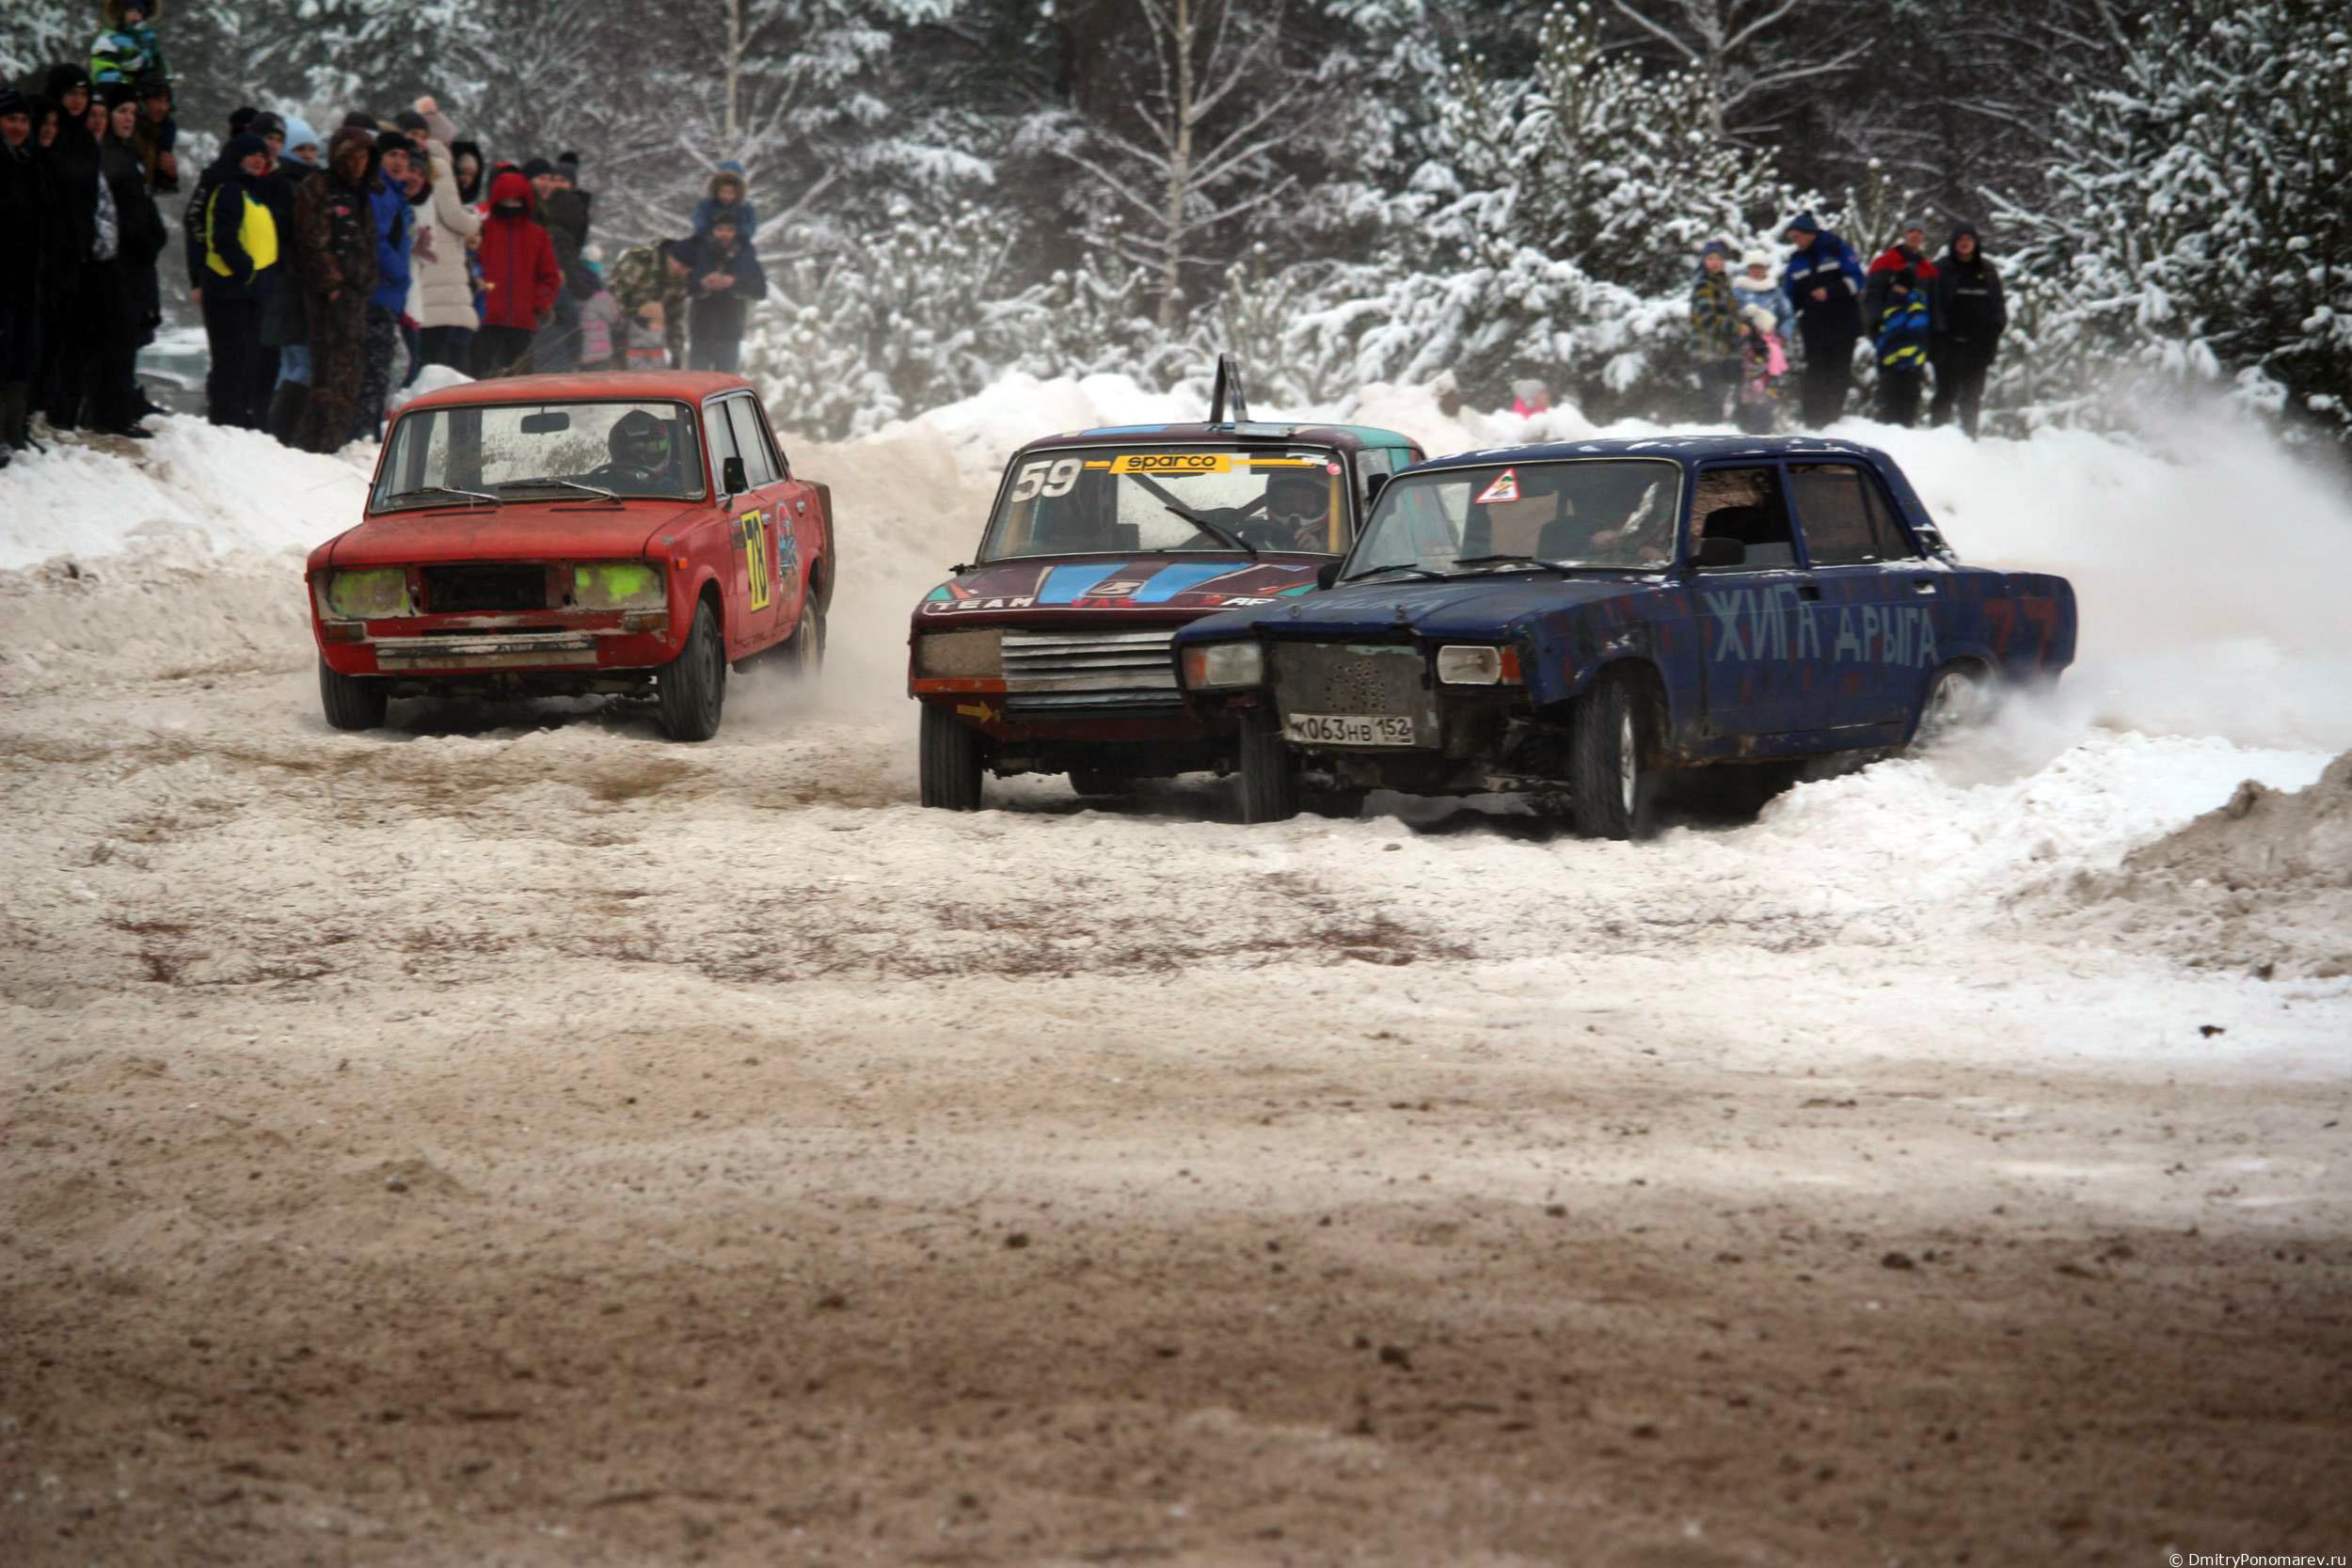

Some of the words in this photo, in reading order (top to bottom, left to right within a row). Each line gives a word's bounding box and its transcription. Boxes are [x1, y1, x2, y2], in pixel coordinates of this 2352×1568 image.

[1011, 458, 1084, 503] 59
[1128, 455, 1216, 470] sparco
[934, 597, 1035, 610] TEAM
[1701, 582, 1822, 662] ЖИГА
[1835, 605, 1941, 669] ДРЫГА
[1983, 597, 2057, 672] 77
